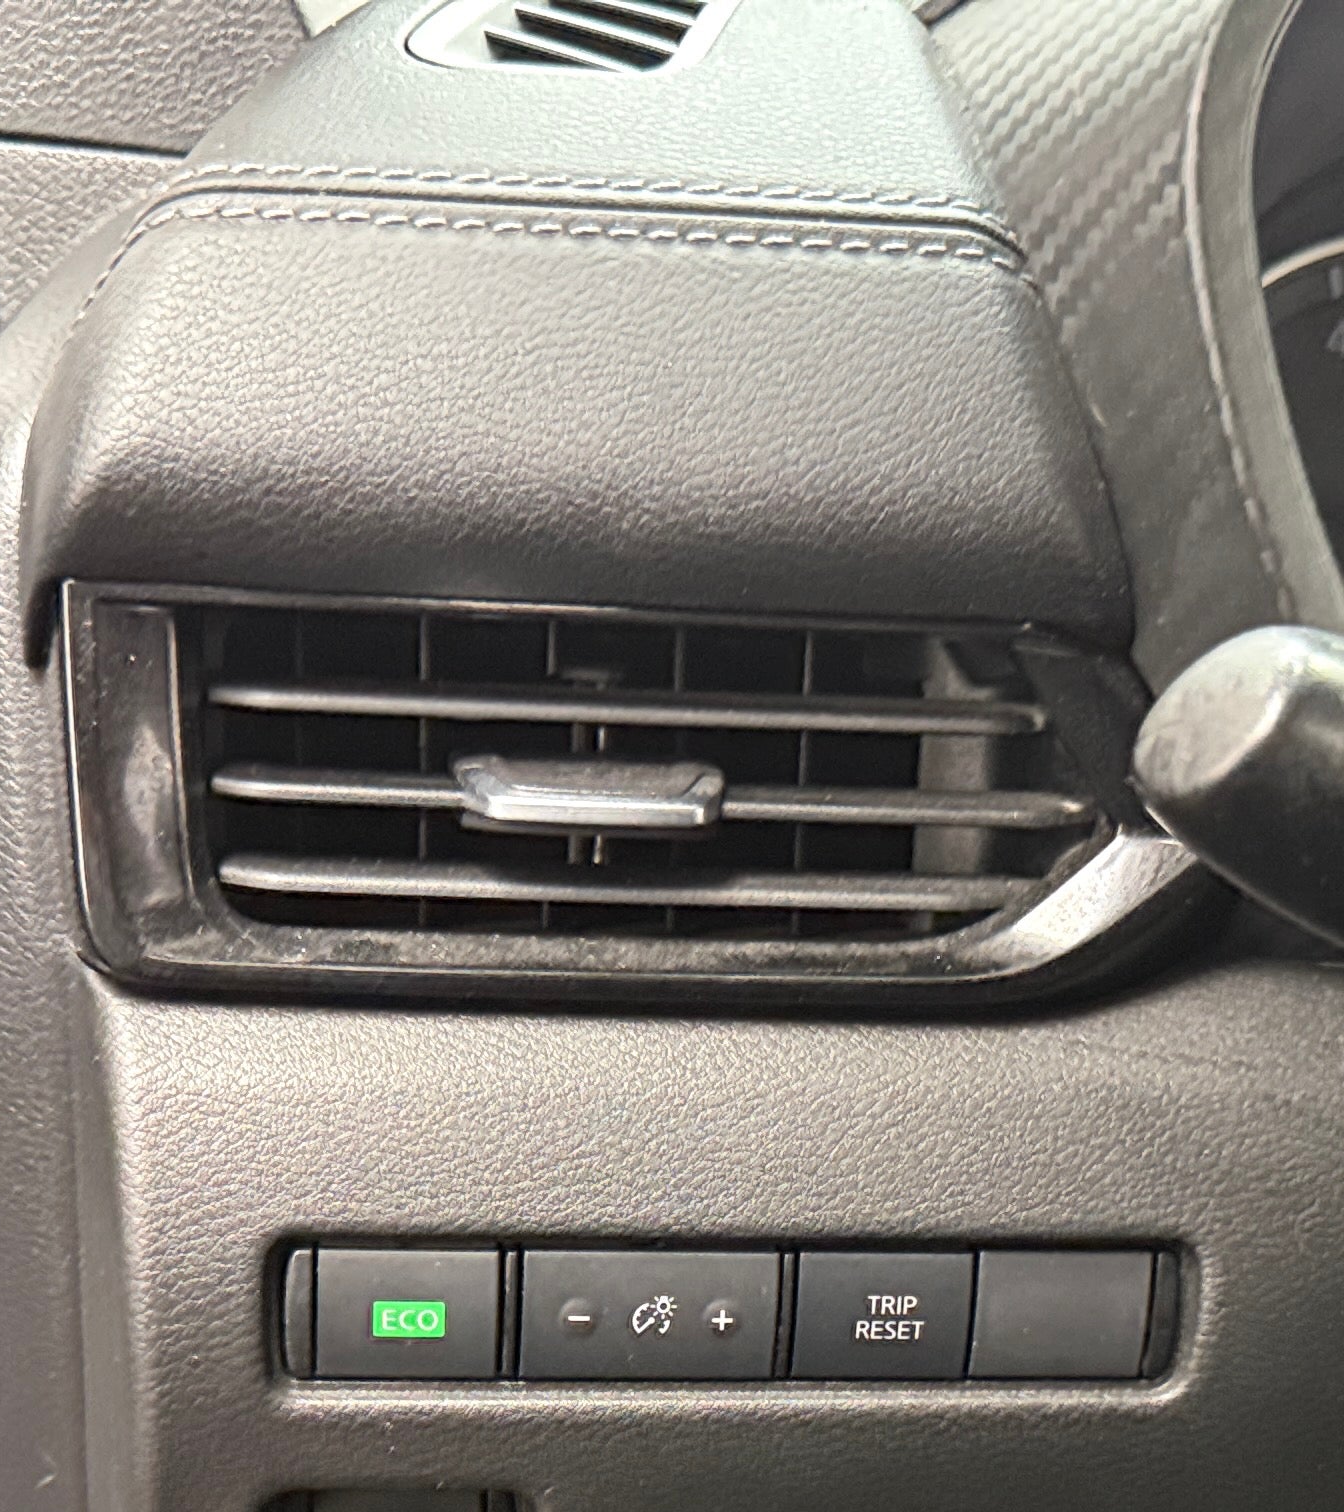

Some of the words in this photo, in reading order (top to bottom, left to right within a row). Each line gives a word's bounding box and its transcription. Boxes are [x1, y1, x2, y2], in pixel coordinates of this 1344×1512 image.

[867, 1295, 918, 1315] TRIP
[381, 1309, 439, 1331] ECO
[855, 1320, 925, 1340] RESET
